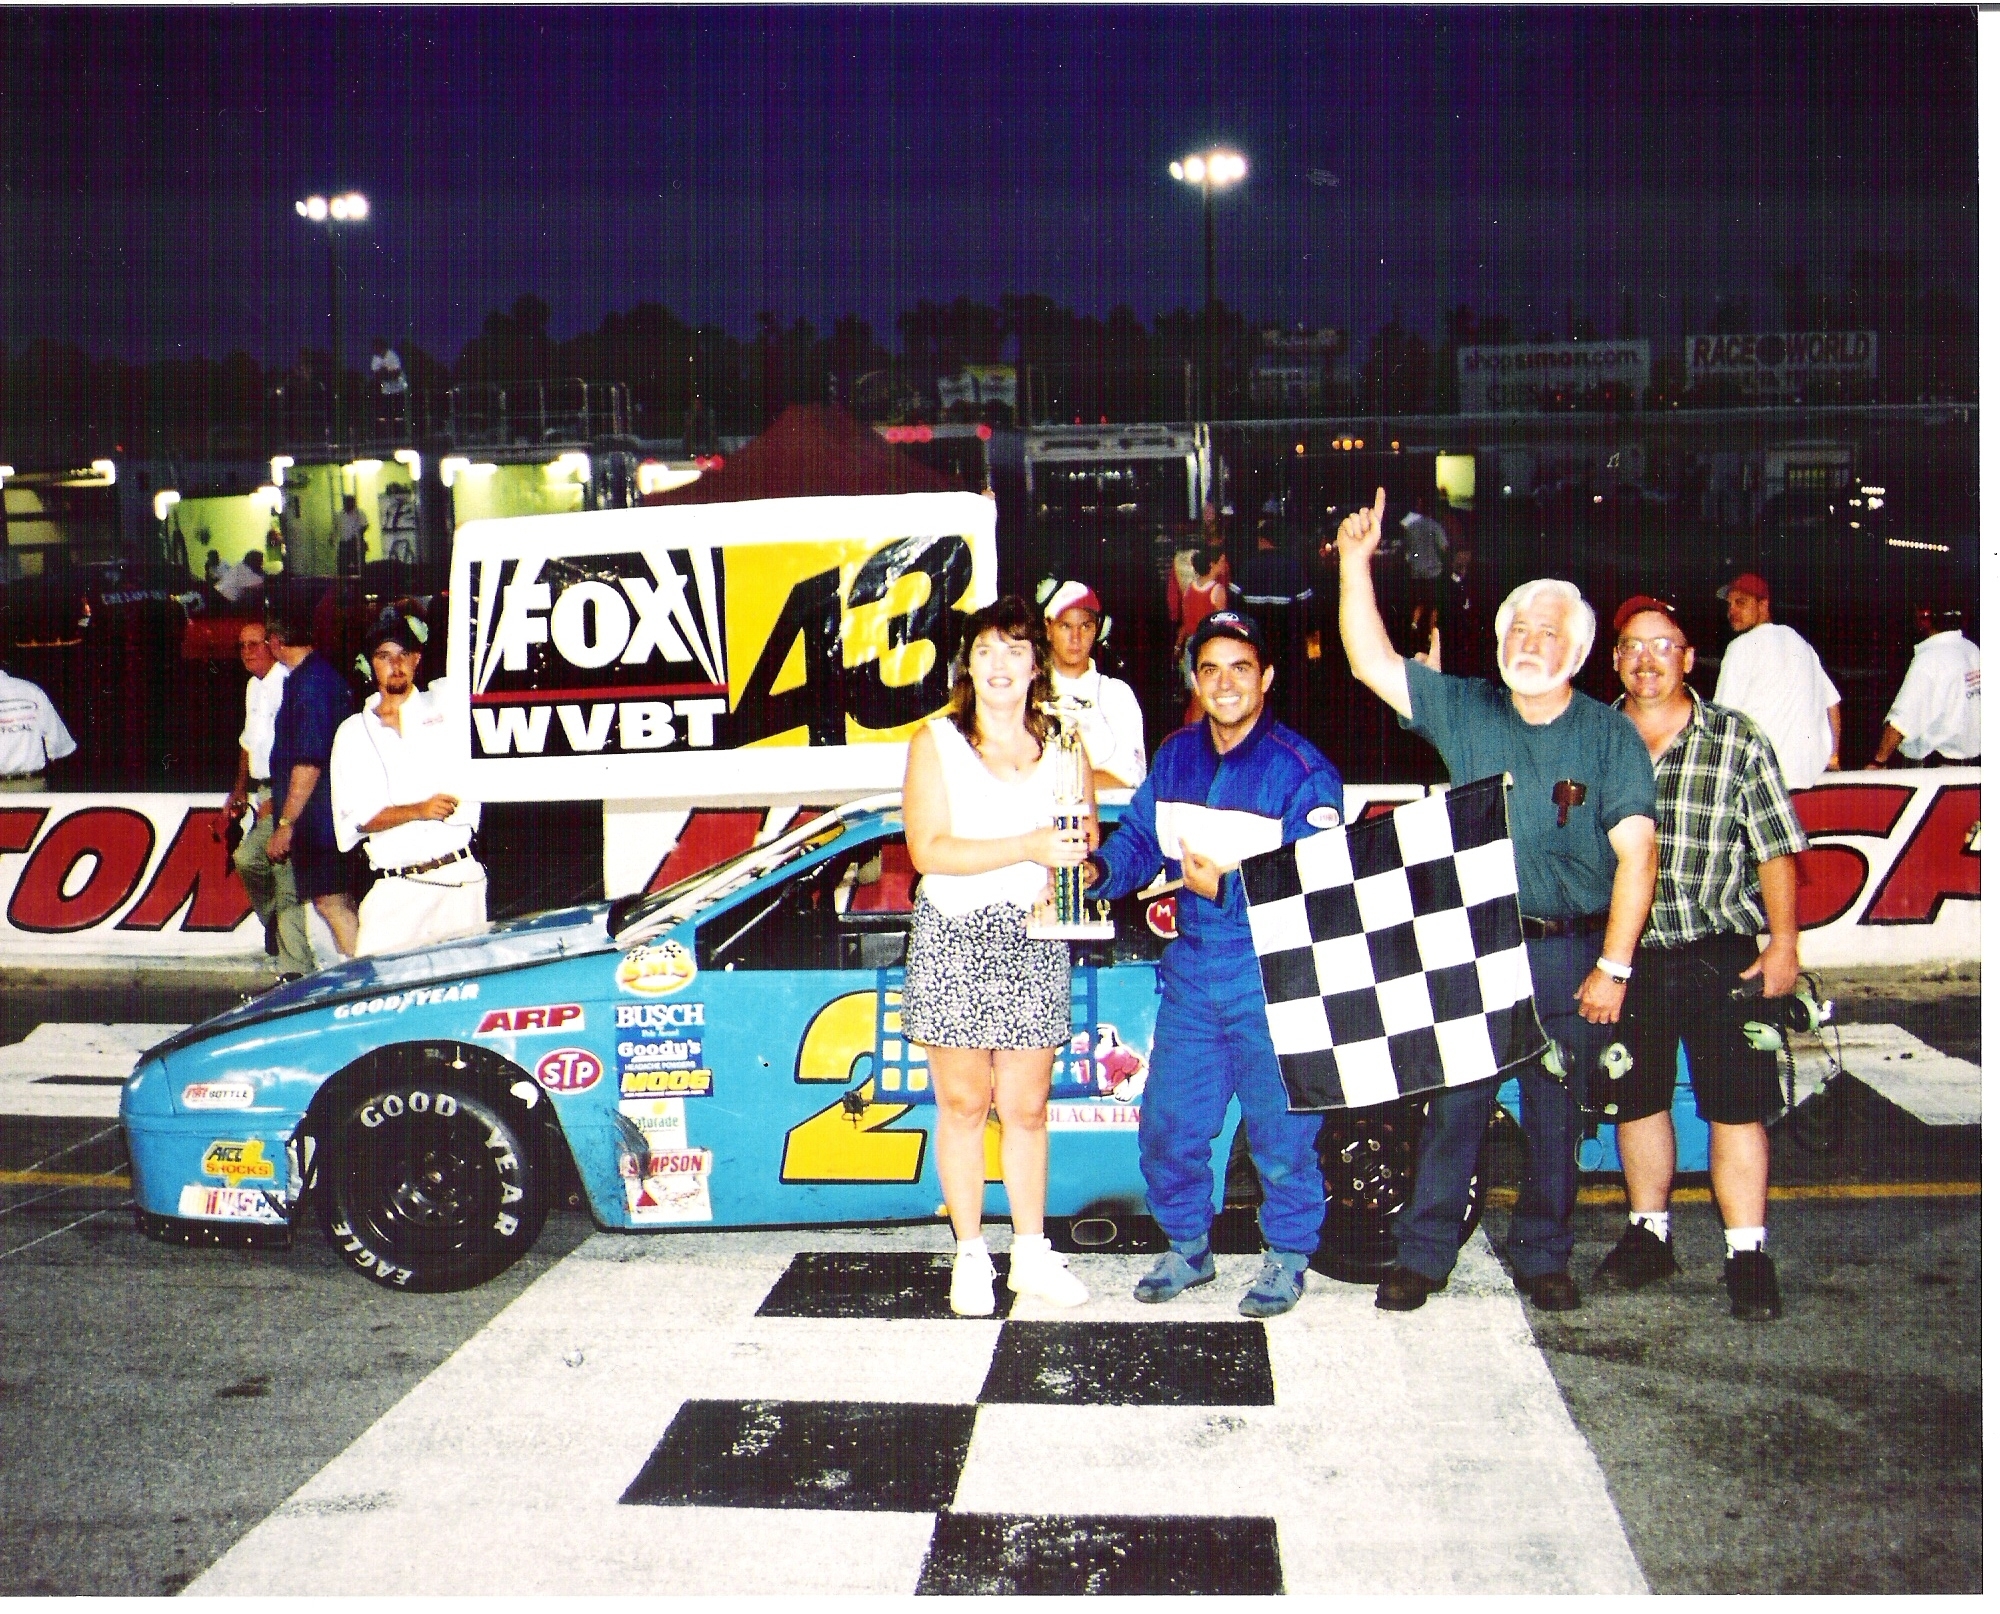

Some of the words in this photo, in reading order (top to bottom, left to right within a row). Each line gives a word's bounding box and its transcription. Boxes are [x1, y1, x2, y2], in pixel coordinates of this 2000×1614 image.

[1694, 335, 1754, 366] RACE
[1787, 333, 1870, 364] WORLD
[503, 574, 693, 672] FOX
[730, 534, 972, 748] 43
[472, 698, 726, 755] WVBT
[333, 983, 480, 1020] GOODYEAR
[616, 1003, 705, 1028] BUSCH
[476, 1004, 582, 1034] ARP
[617, 1038, 702, 1063] Goody's
[543, 1052, 594, 1086] STP
[620, 1069, 712, 1093] MOOG
[1047, 1107, 1103, 1124] BLACK
[205, 1162, 269, 1176] SHOCKS
[360, 1090, 457, 1128] GOOD
[484, 1126, 524, 1237] YEAR
[628, 1154, 704, 1176] SMPSON
[331, 1221, 413, 1286] EAGLE
